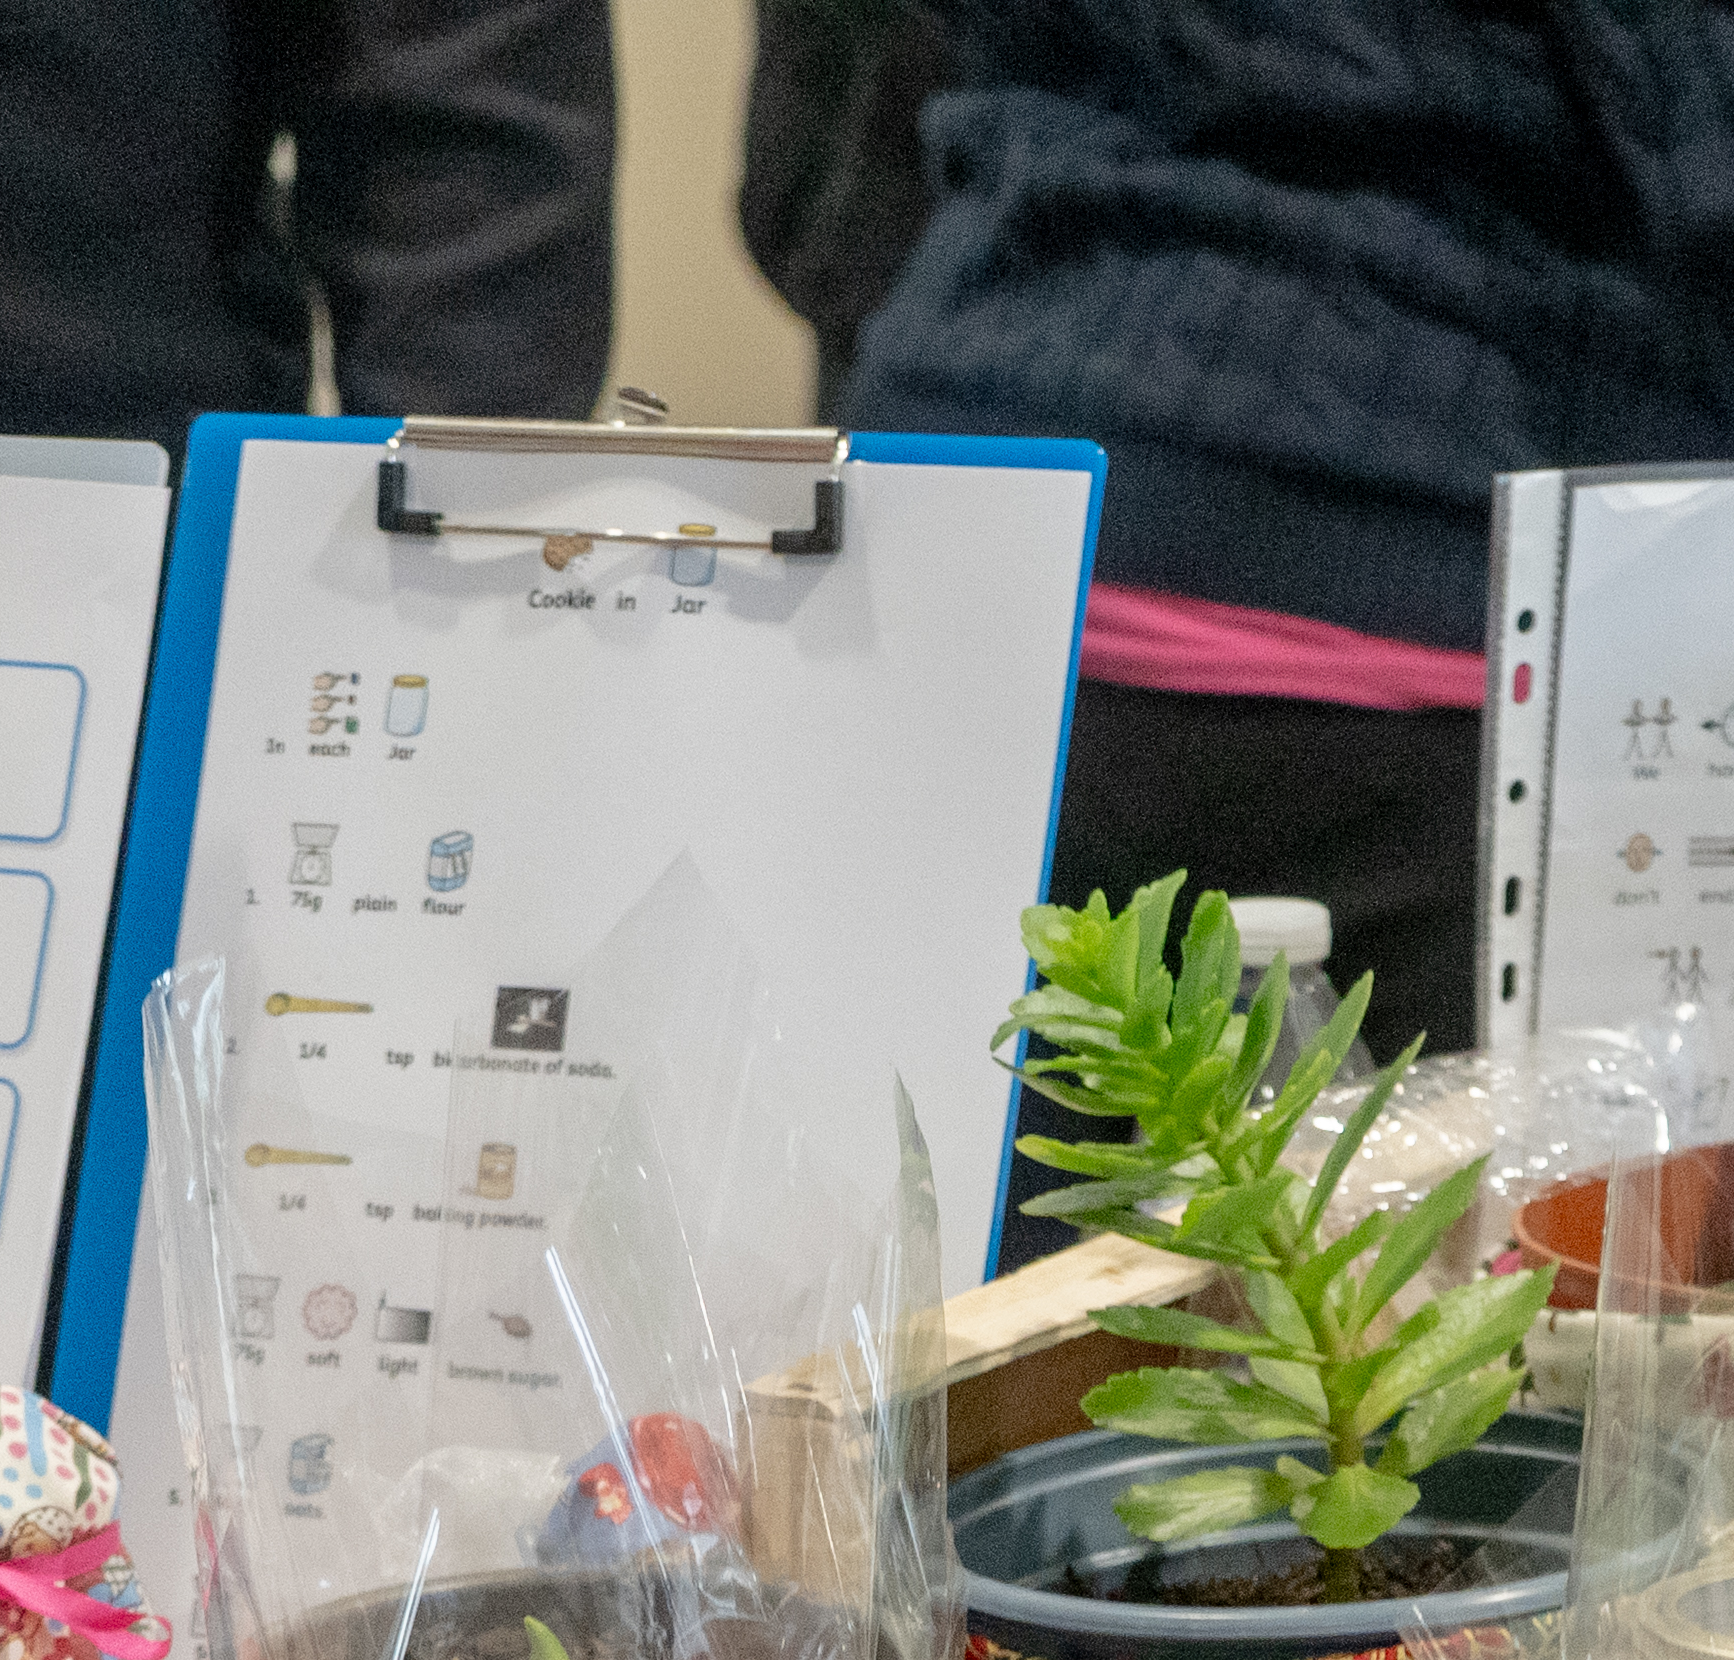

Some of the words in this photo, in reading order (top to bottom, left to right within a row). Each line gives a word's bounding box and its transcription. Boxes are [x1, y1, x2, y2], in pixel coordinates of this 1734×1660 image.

[528, 588, 596, 611] Cookie
[616, 593, 637, 611] in
[671, 594, 707, 616] Jar
[309, 739, 351, 757] each
[353, 894, 397, 915] plain
[422, 896, 465, 915] flour
[300, 1043, 327, 1059] 1/4
[386, 1051, 414, 1068] tsp
[544, 1059, 563, 1074] of
[367, 1201, 394, 1221] tsp
[307, 1352, 341, 1367] soft
[378, 1355, 418, 1378] light
[448, 1362, 503, 1381] brown
